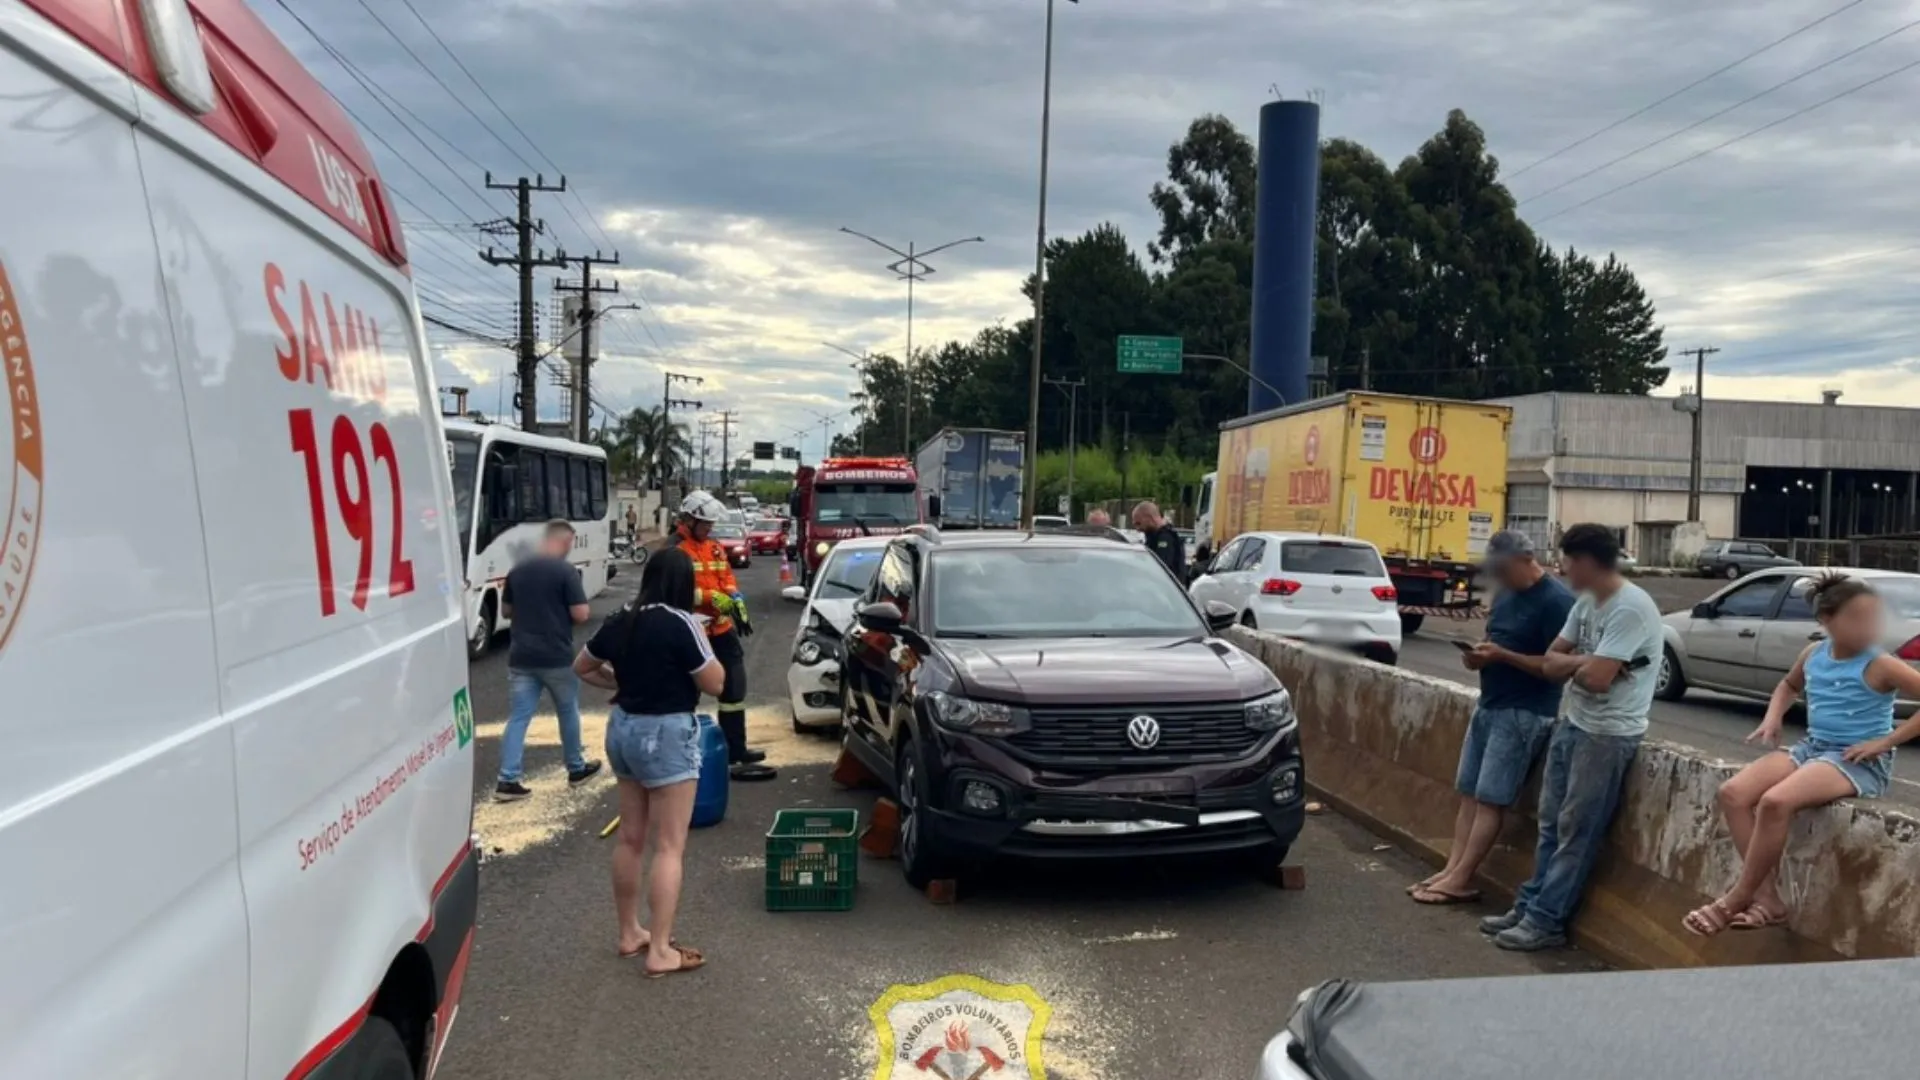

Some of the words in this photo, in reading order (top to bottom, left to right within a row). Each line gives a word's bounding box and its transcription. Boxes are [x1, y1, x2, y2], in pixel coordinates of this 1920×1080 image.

[307, 134, 373, 235] USA
[0, 284, 33, 440] GÊNCIA
[264, 262, 386, 402] SAMU
[288, 408, 415, 617] 192
[825, 469, 908, 481] BOMBEIROS
[1369, 467, 1476, 508] DEVASSA
[1419, 508, 1455, 521] MLTE
[298, 821, 340, 871] Serviço
[340, 801, 355, 835] de
[355, 765, 407, 821] Atendimento
